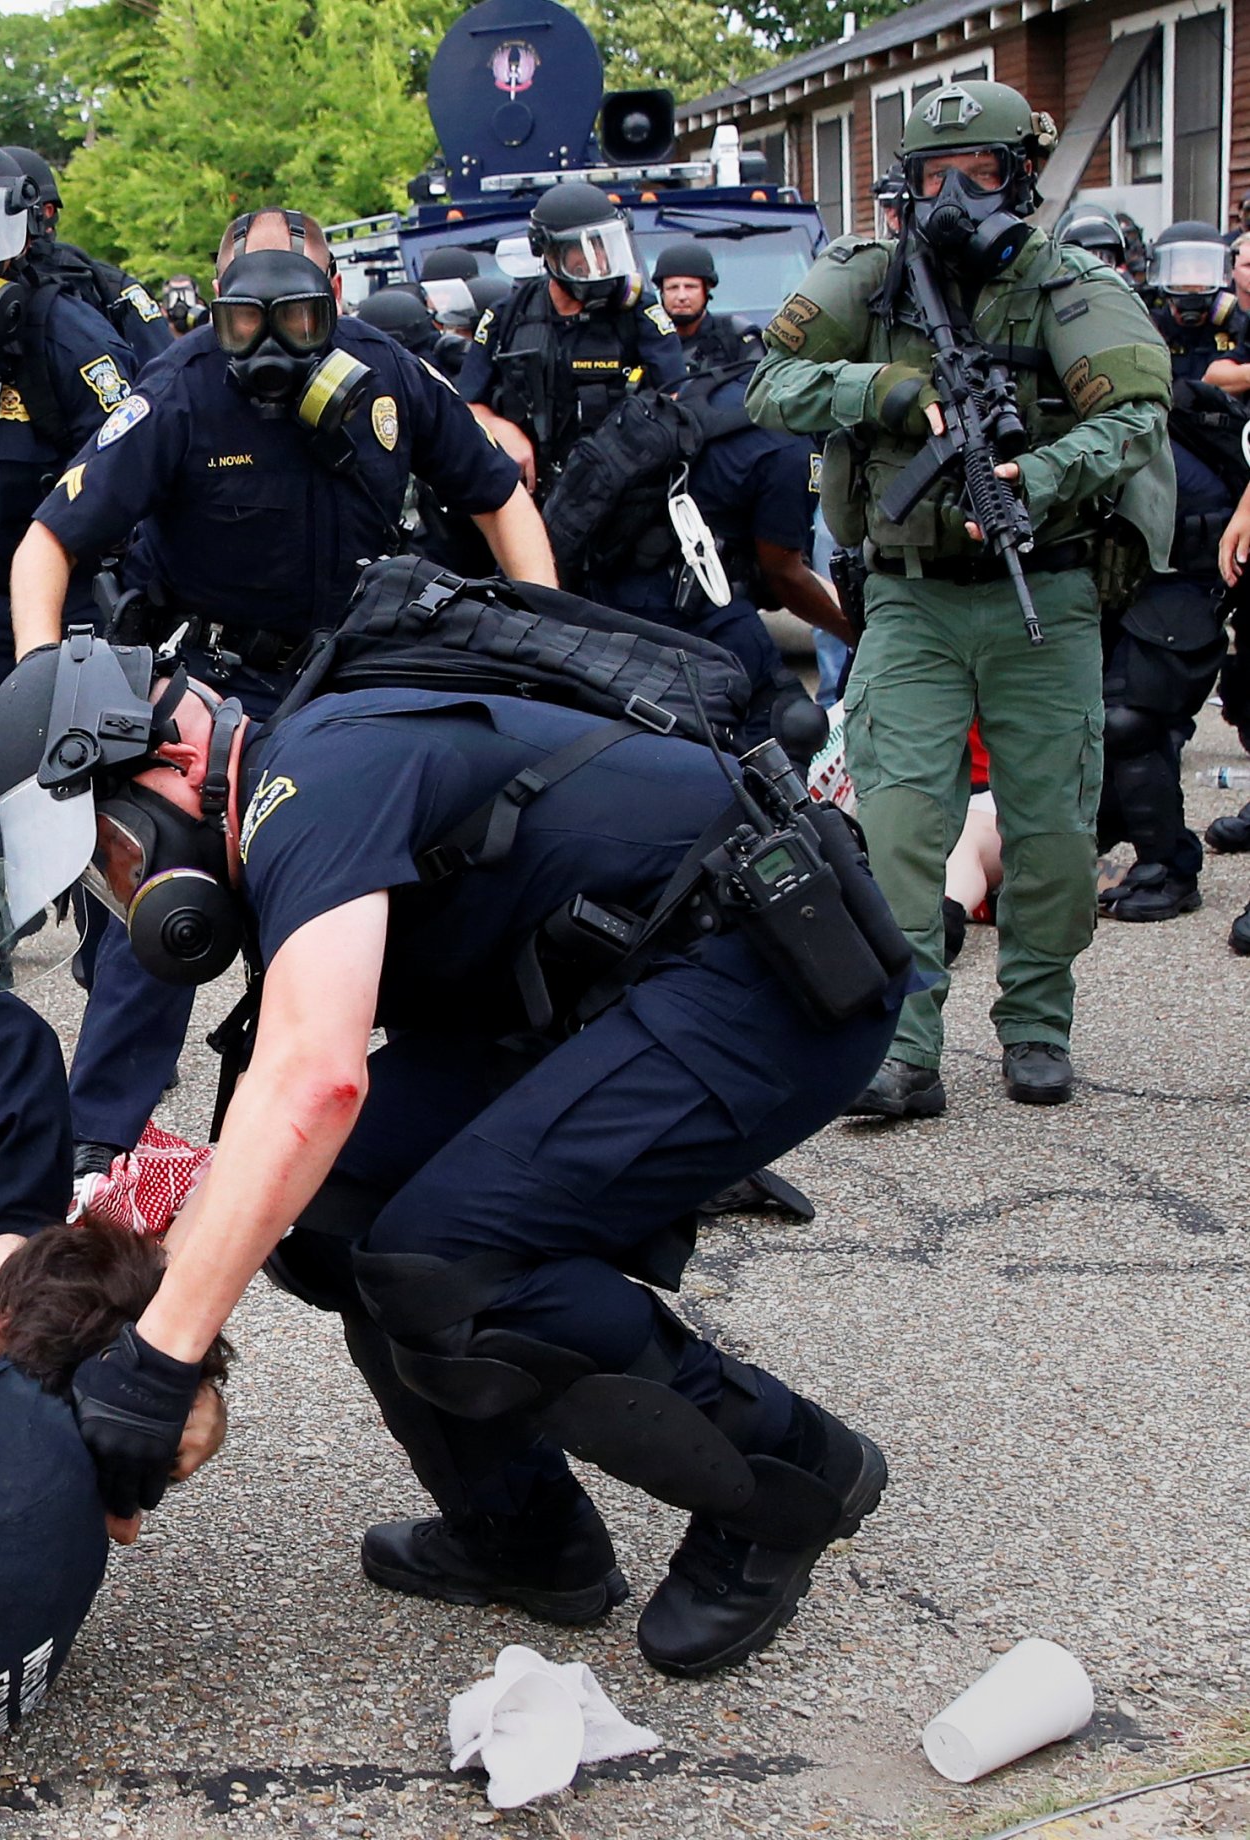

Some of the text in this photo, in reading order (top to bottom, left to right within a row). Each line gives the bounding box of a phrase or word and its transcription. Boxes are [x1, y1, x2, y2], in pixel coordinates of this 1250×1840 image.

[572, 360, 620, 369] STATE POLICE
[207, 454, 254, 468] J. NOVAK
[255, 783, 286, 819] POLICE
